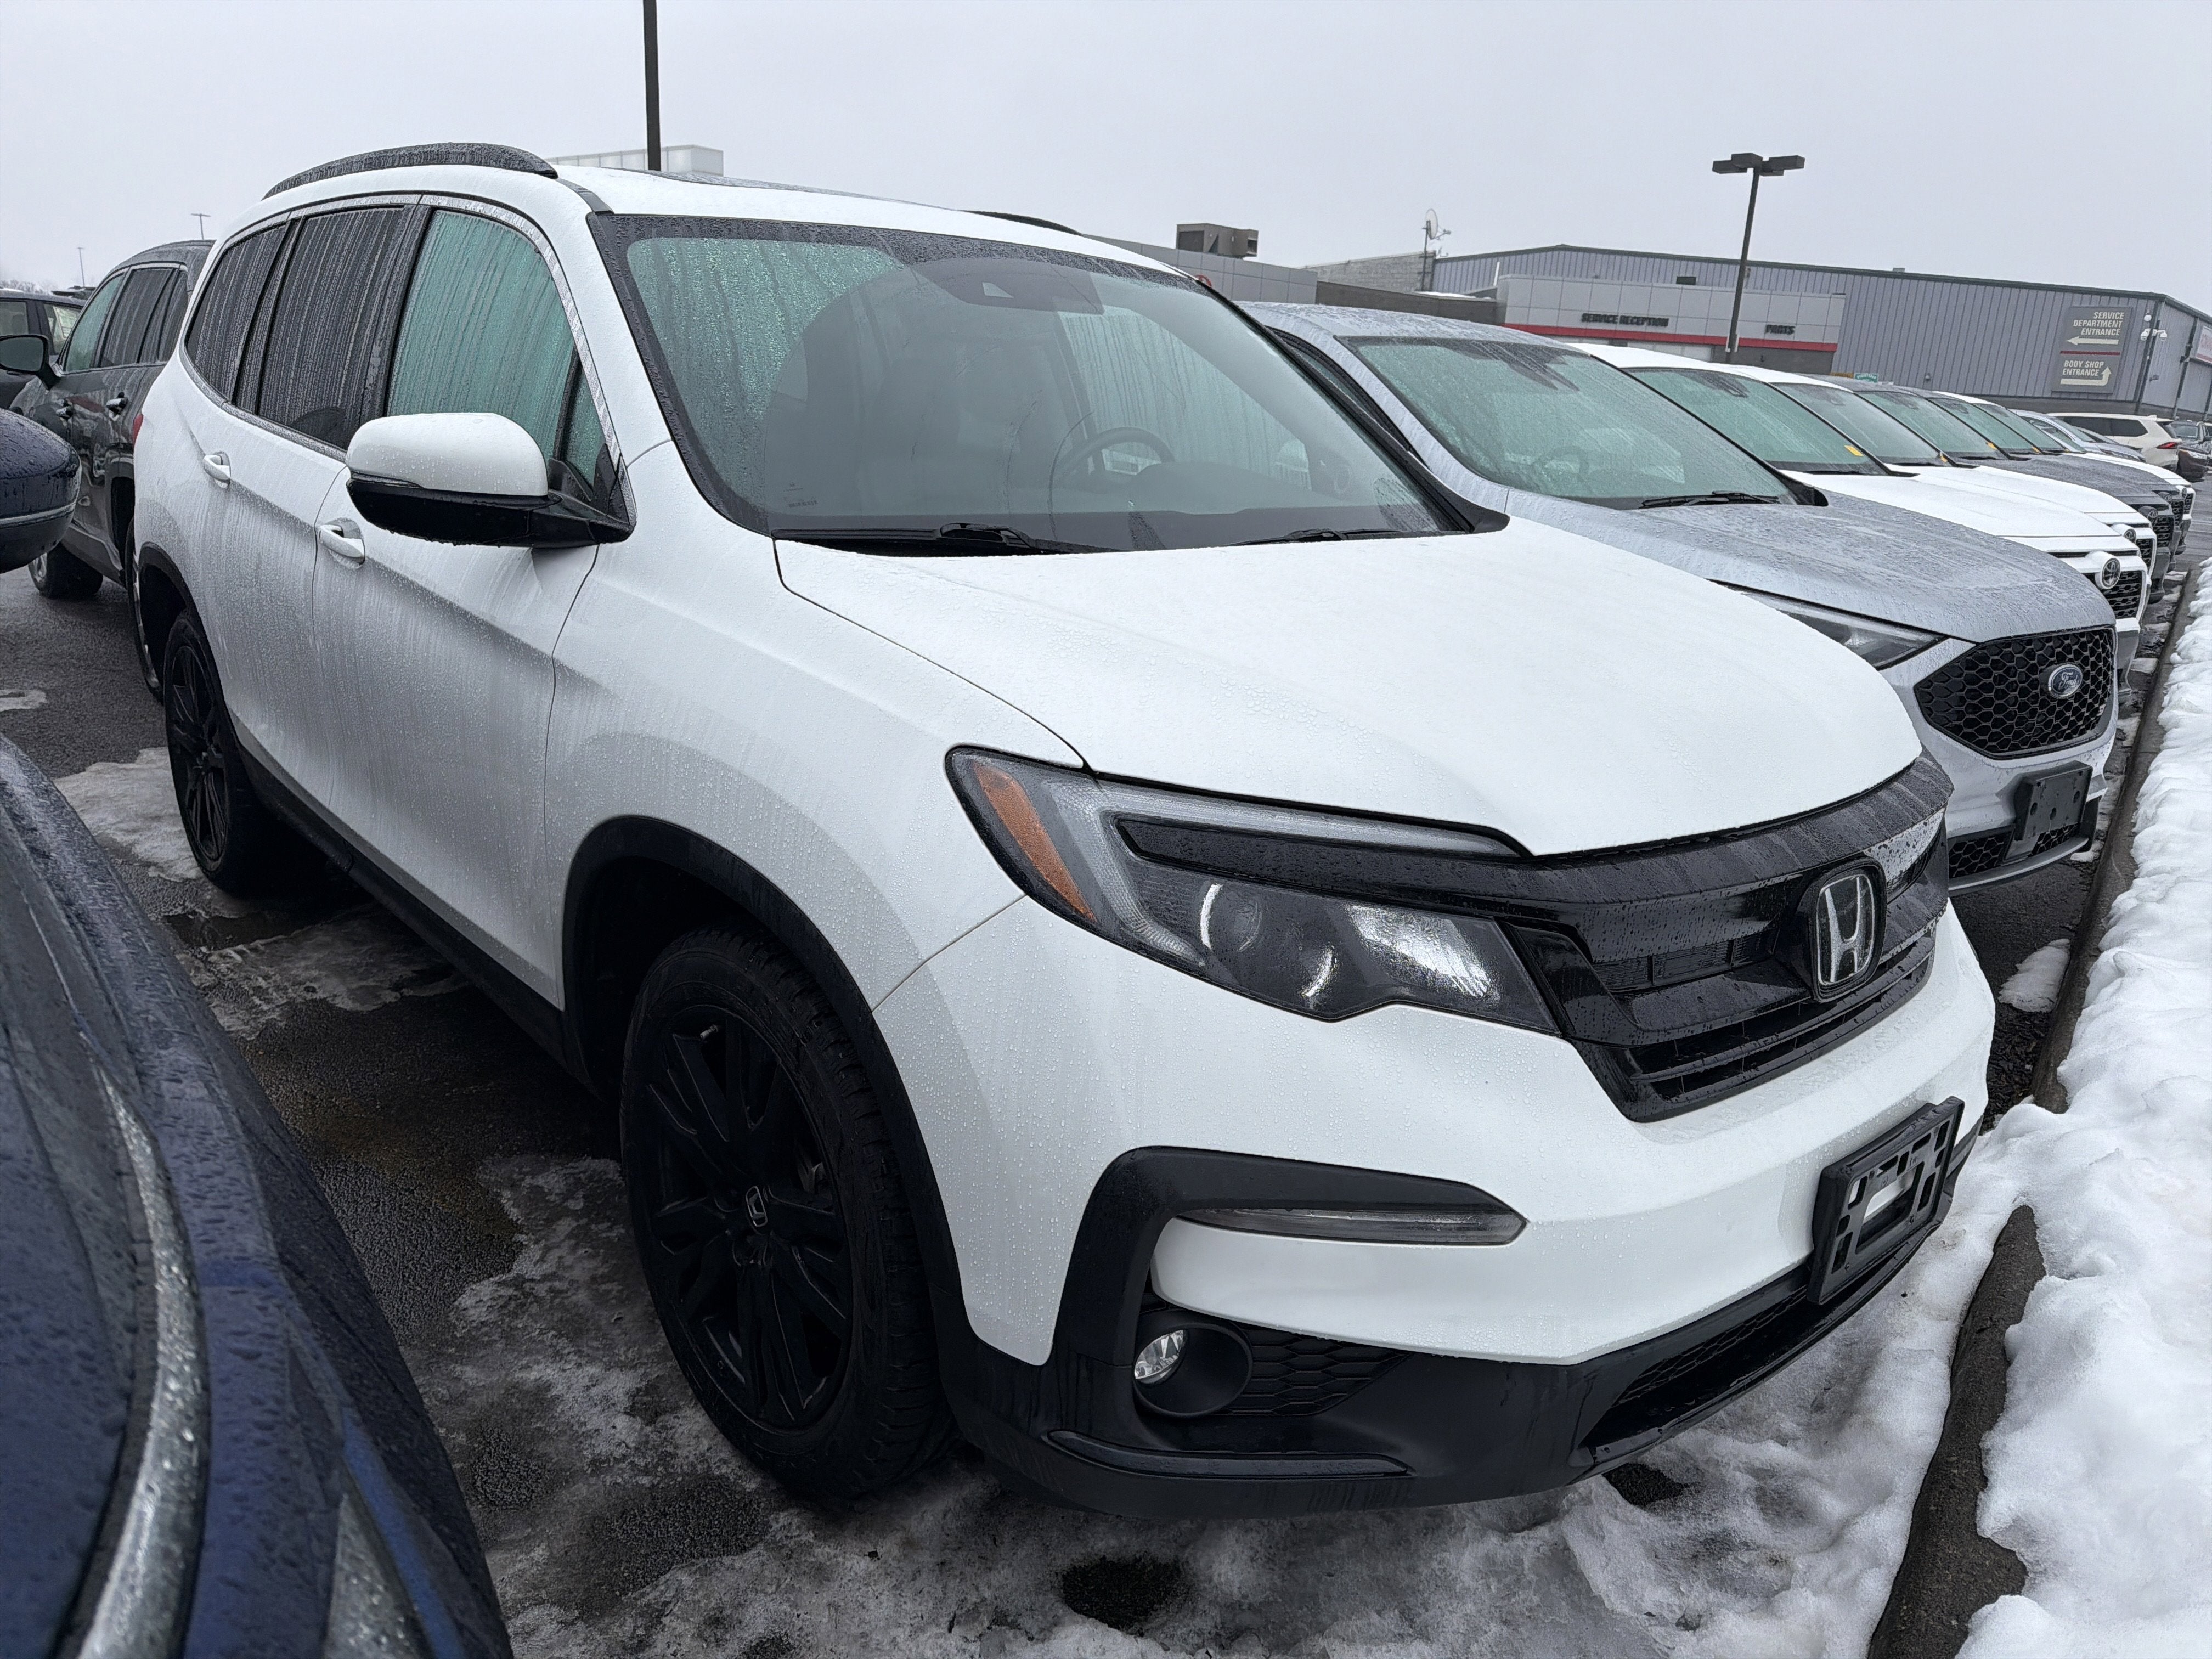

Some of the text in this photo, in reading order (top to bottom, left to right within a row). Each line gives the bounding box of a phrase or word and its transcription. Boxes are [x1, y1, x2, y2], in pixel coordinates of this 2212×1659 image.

[1582, 313, 1669, 327] SERVICE RECEPTION
[2073, 319, 2123, 328] DEPARTMENT
[1765, 324, 1795, 335] PARTS
[2063, 368, 2100, 376] ENTRANCE
[2058, 671, 2080, 691] Ford
